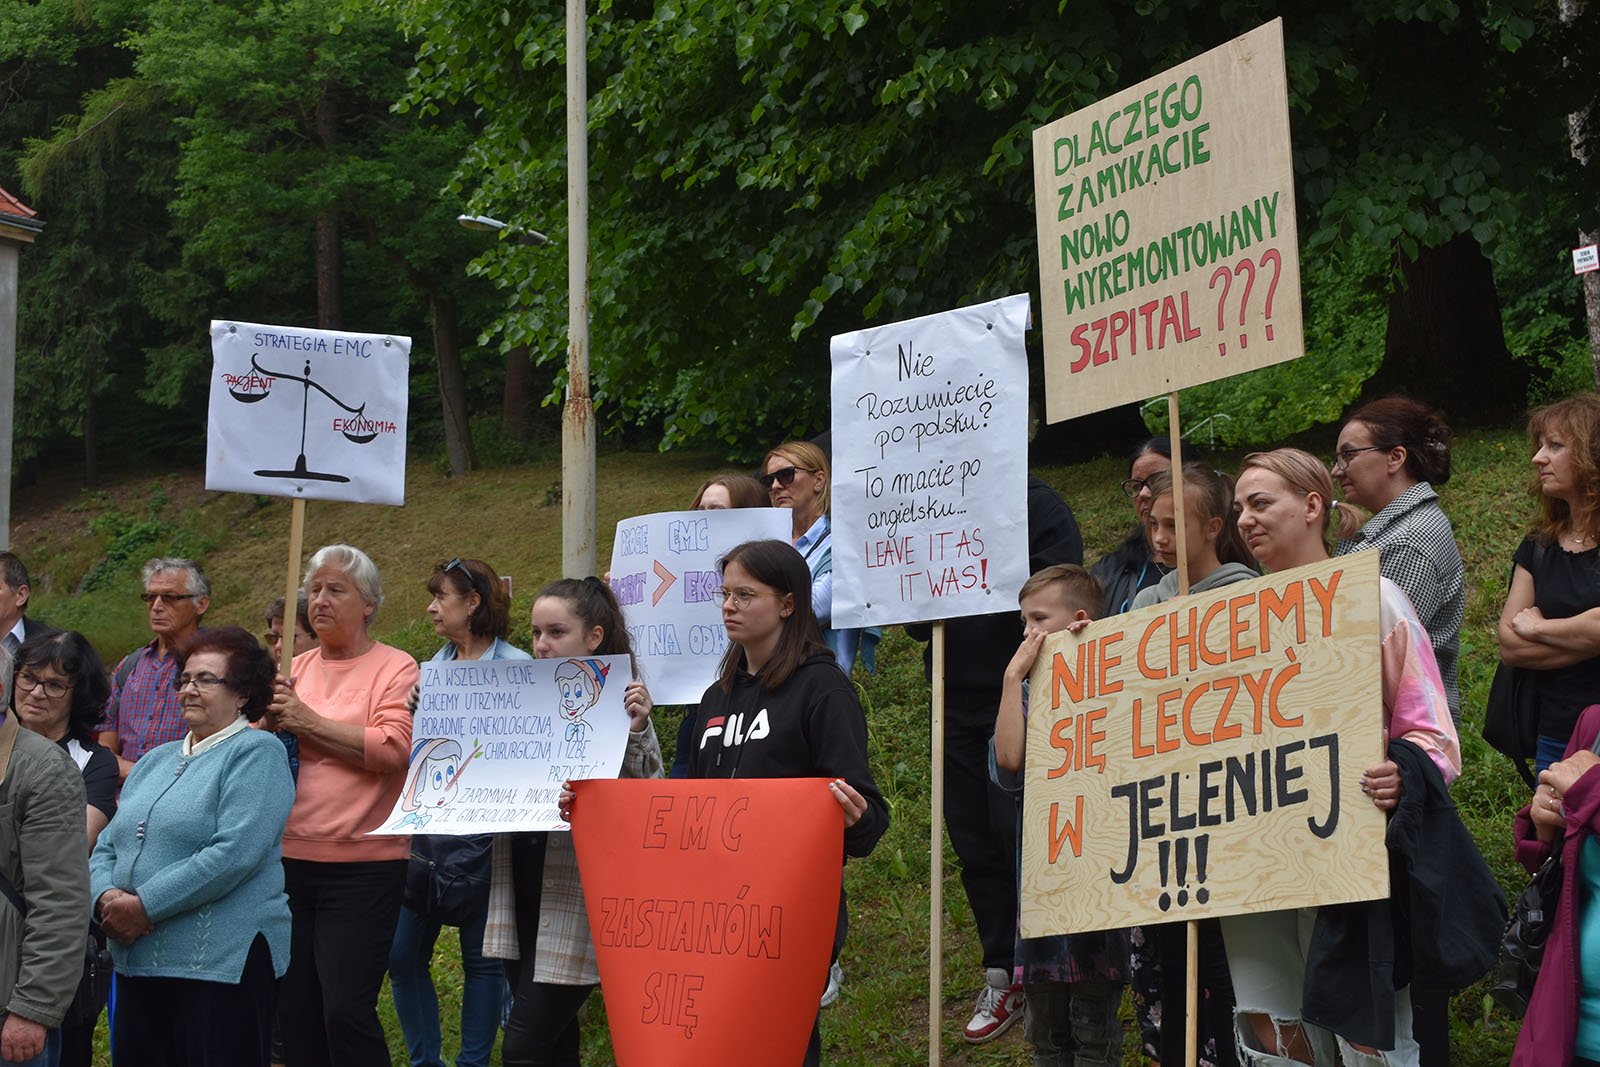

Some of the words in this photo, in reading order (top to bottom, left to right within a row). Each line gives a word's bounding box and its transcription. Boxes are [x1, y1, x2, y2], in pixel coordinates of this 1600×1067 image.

[1053, 74, 1202, 177] DLACZEGO
[1057, 122, 1210, 221] ZAMYKACIE
[1060, 209, 1129, 270] NOWO
[1064, 191, 1279, 315] WYREMONTOWANY
[1070, 290, 1201, 374] SZPITAL
[1209, 248, 1281, 356] ???
[254, 333, 327, 353] STRATEGIA
[333, 338, 372, 358] EMC
[898, 340, 935, 381] Nie
[856, 373, 998, 420] Rozumiecie
[333, 418, 396, 434] EKONOMIA
[874, 425, 905, 459] po
[909, 401, 993, 452] polsku?
[854, 465, 884, 498] To
[891, 460, 954, 495] macie
[960, 459, 981, 497] po
[668, 518, 709, 554] EMC
[867, 495, 967, 538] angielsku...
[865, 536, 915, 569] LEAVE
[929, 531, 953, 561] IT
[956, 528, 984, 558] AS
[900, 571, 922, 601] IT
[927, 559, 988, 598] WAS!
[648, 624, 681, 656] NA
[1051, 631, 1124, 710] NIE
[1137, 569, 1343, 680] CHCEMY
[445, 666, 500, 687] WSZELKĄ
[422, 693, 460, 711] CHCEMY
[465, 686, 522, 711] UTRZYMAĆ
[1047, 707, 1107, 780] SIĘ
[1132, 646, 1304, 759] LECZYĆ
[421, 716, 466, 738] PORADNIĘ
[700, 708, 770, 750] FILA
[484, 741, 551, 761] CHIRURGICZNĄ
[564, 740, 592, 761] IZBĘ
[457, 787, 518, 804] ZAPOMNIAŁ
[1048, 795, 1084, 864] W
[1110, 733, 1340, 884] JELENIEJ
[643, 796, 749, 852] EMC
[1158, 834, 1210, 912] !!!
[600, 885, 783, 960] ZASTANÓW
[641, 972, 704, 1040] SIĘ
